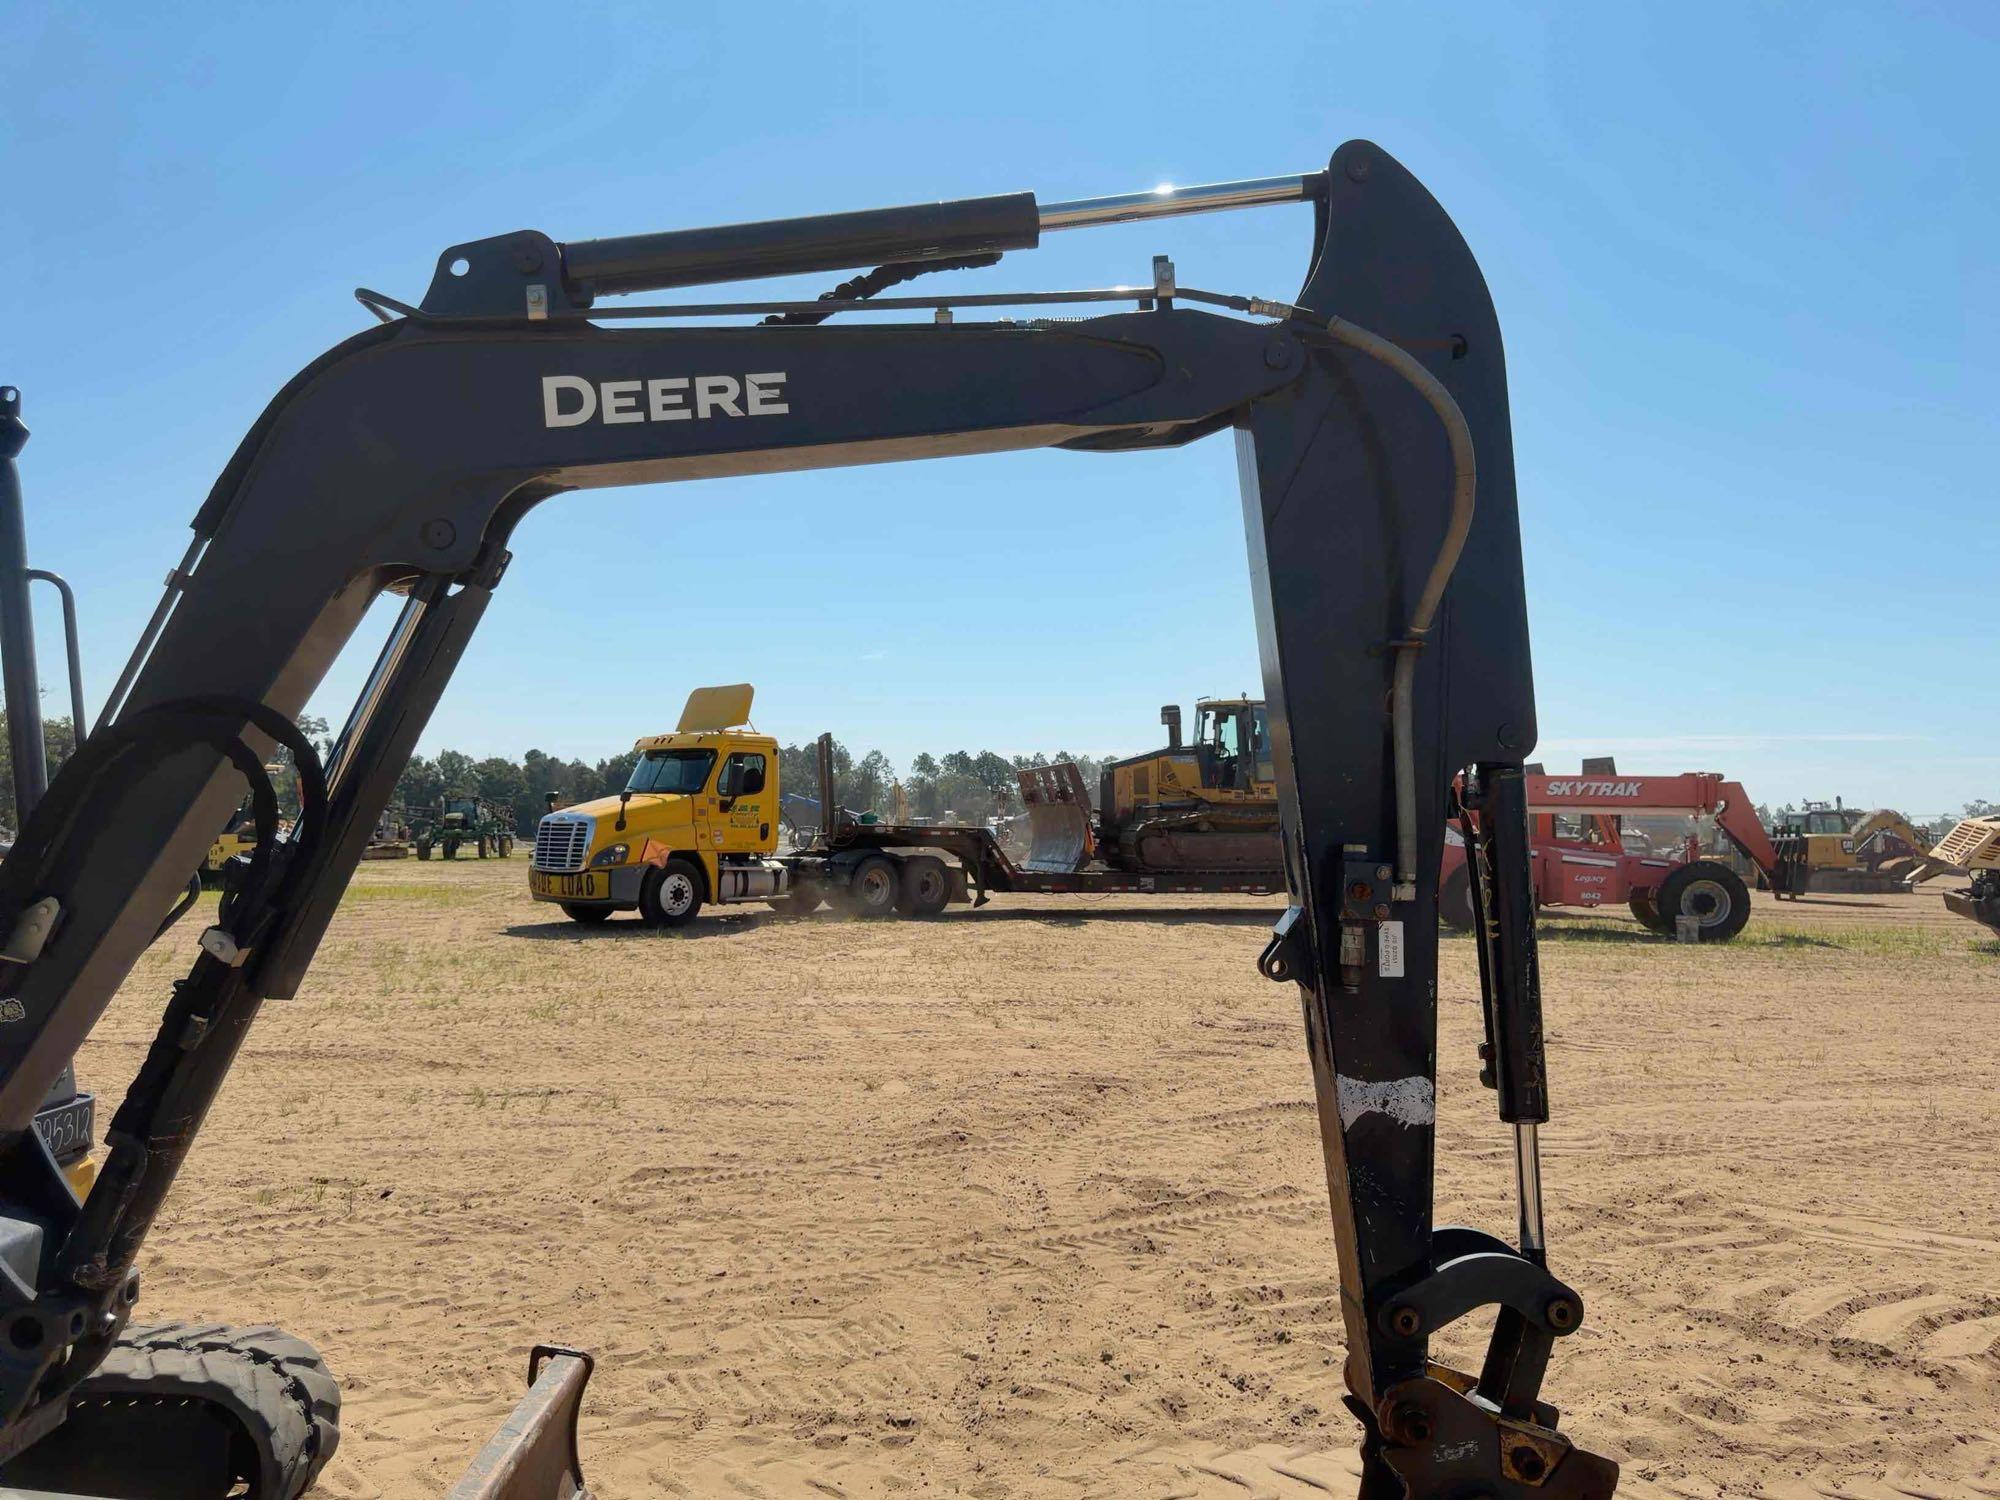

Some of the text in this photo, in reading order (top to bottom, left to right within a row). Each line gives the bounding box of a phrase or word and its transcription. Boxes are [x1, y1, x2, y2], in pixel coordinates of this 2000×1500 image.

[542, 372, 790, 428] DEERE
[1546, 781, 1642, 797] SKYTRAK
[560, 874, 595, 896] LOAD
